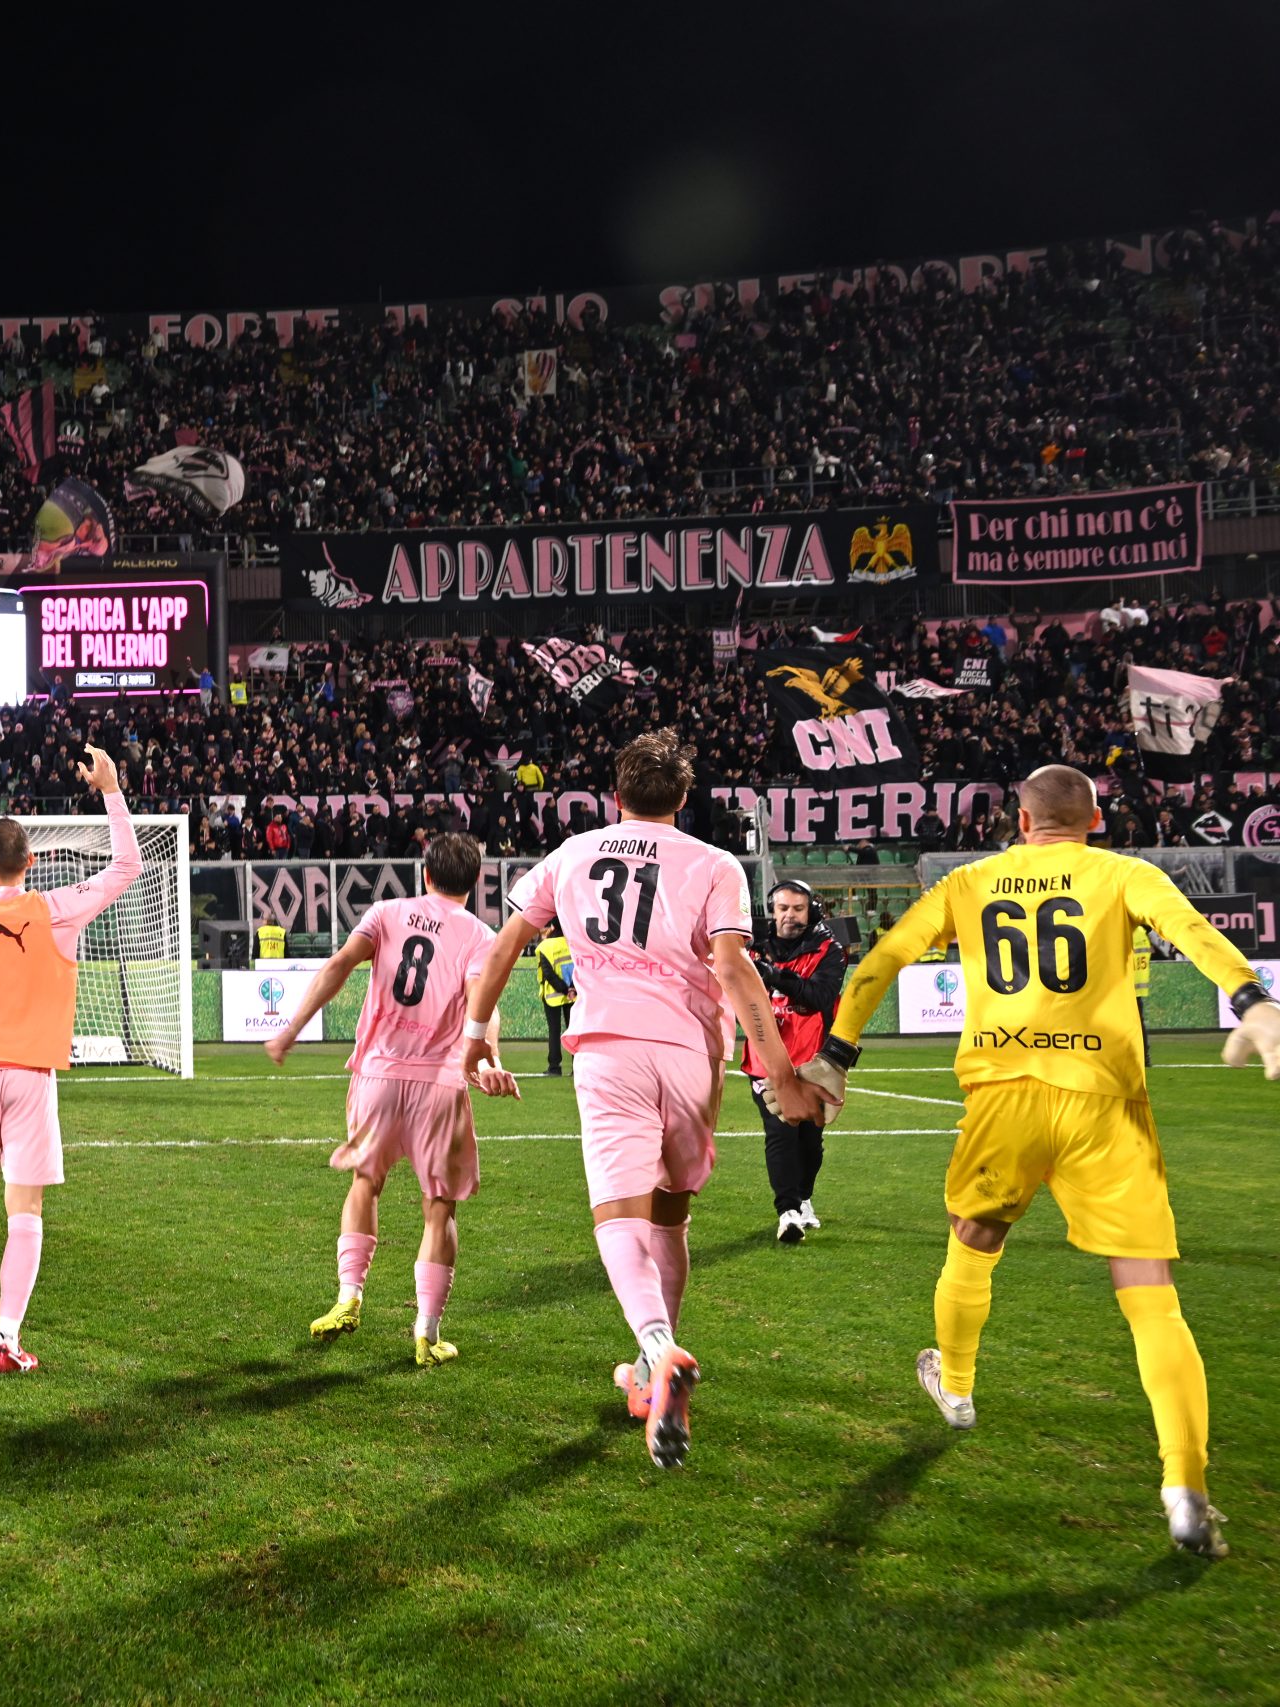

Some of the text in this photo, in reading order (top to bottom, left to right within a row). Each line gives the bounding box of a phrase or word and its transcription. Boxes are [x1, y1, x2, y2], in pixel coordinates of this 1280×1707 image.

[971, 513, 1019, 541] Per
[1024, 504, 1069, 541] chi
[1076, 505, 1134, 537] non
[113, 559, 177, 569] PALERMO
[382, 521, 835, 604] APPARTENENZA
[968, 534, 1187, 573] ma è sempre con noi
[41, 597, 188, 632] SCARICA L'APP
[41, 632, 168, 668] DEL PALERMO
[963, 657, 988, 670] CNI
[960, 670, 987, 678] ROCCA
[792, 708, 903, 770] CNI
[712, 779, 1107, 845] INFERIO
[599, 839, 658, 859] CORONA
[990, 873, 1072, 895] JORONEN
[585, 857, 660, 950] 31
[407, 912, 444, 936] SEGRE
[981, 896, 1088, 995] 66
[392, 934, 434, 1007] 8
[245, 1018, 291, 1028] PRAGM
[921, 1008, 965, 1018] PRAGM
[973, 1026, 1102, 1051] inX.aero
